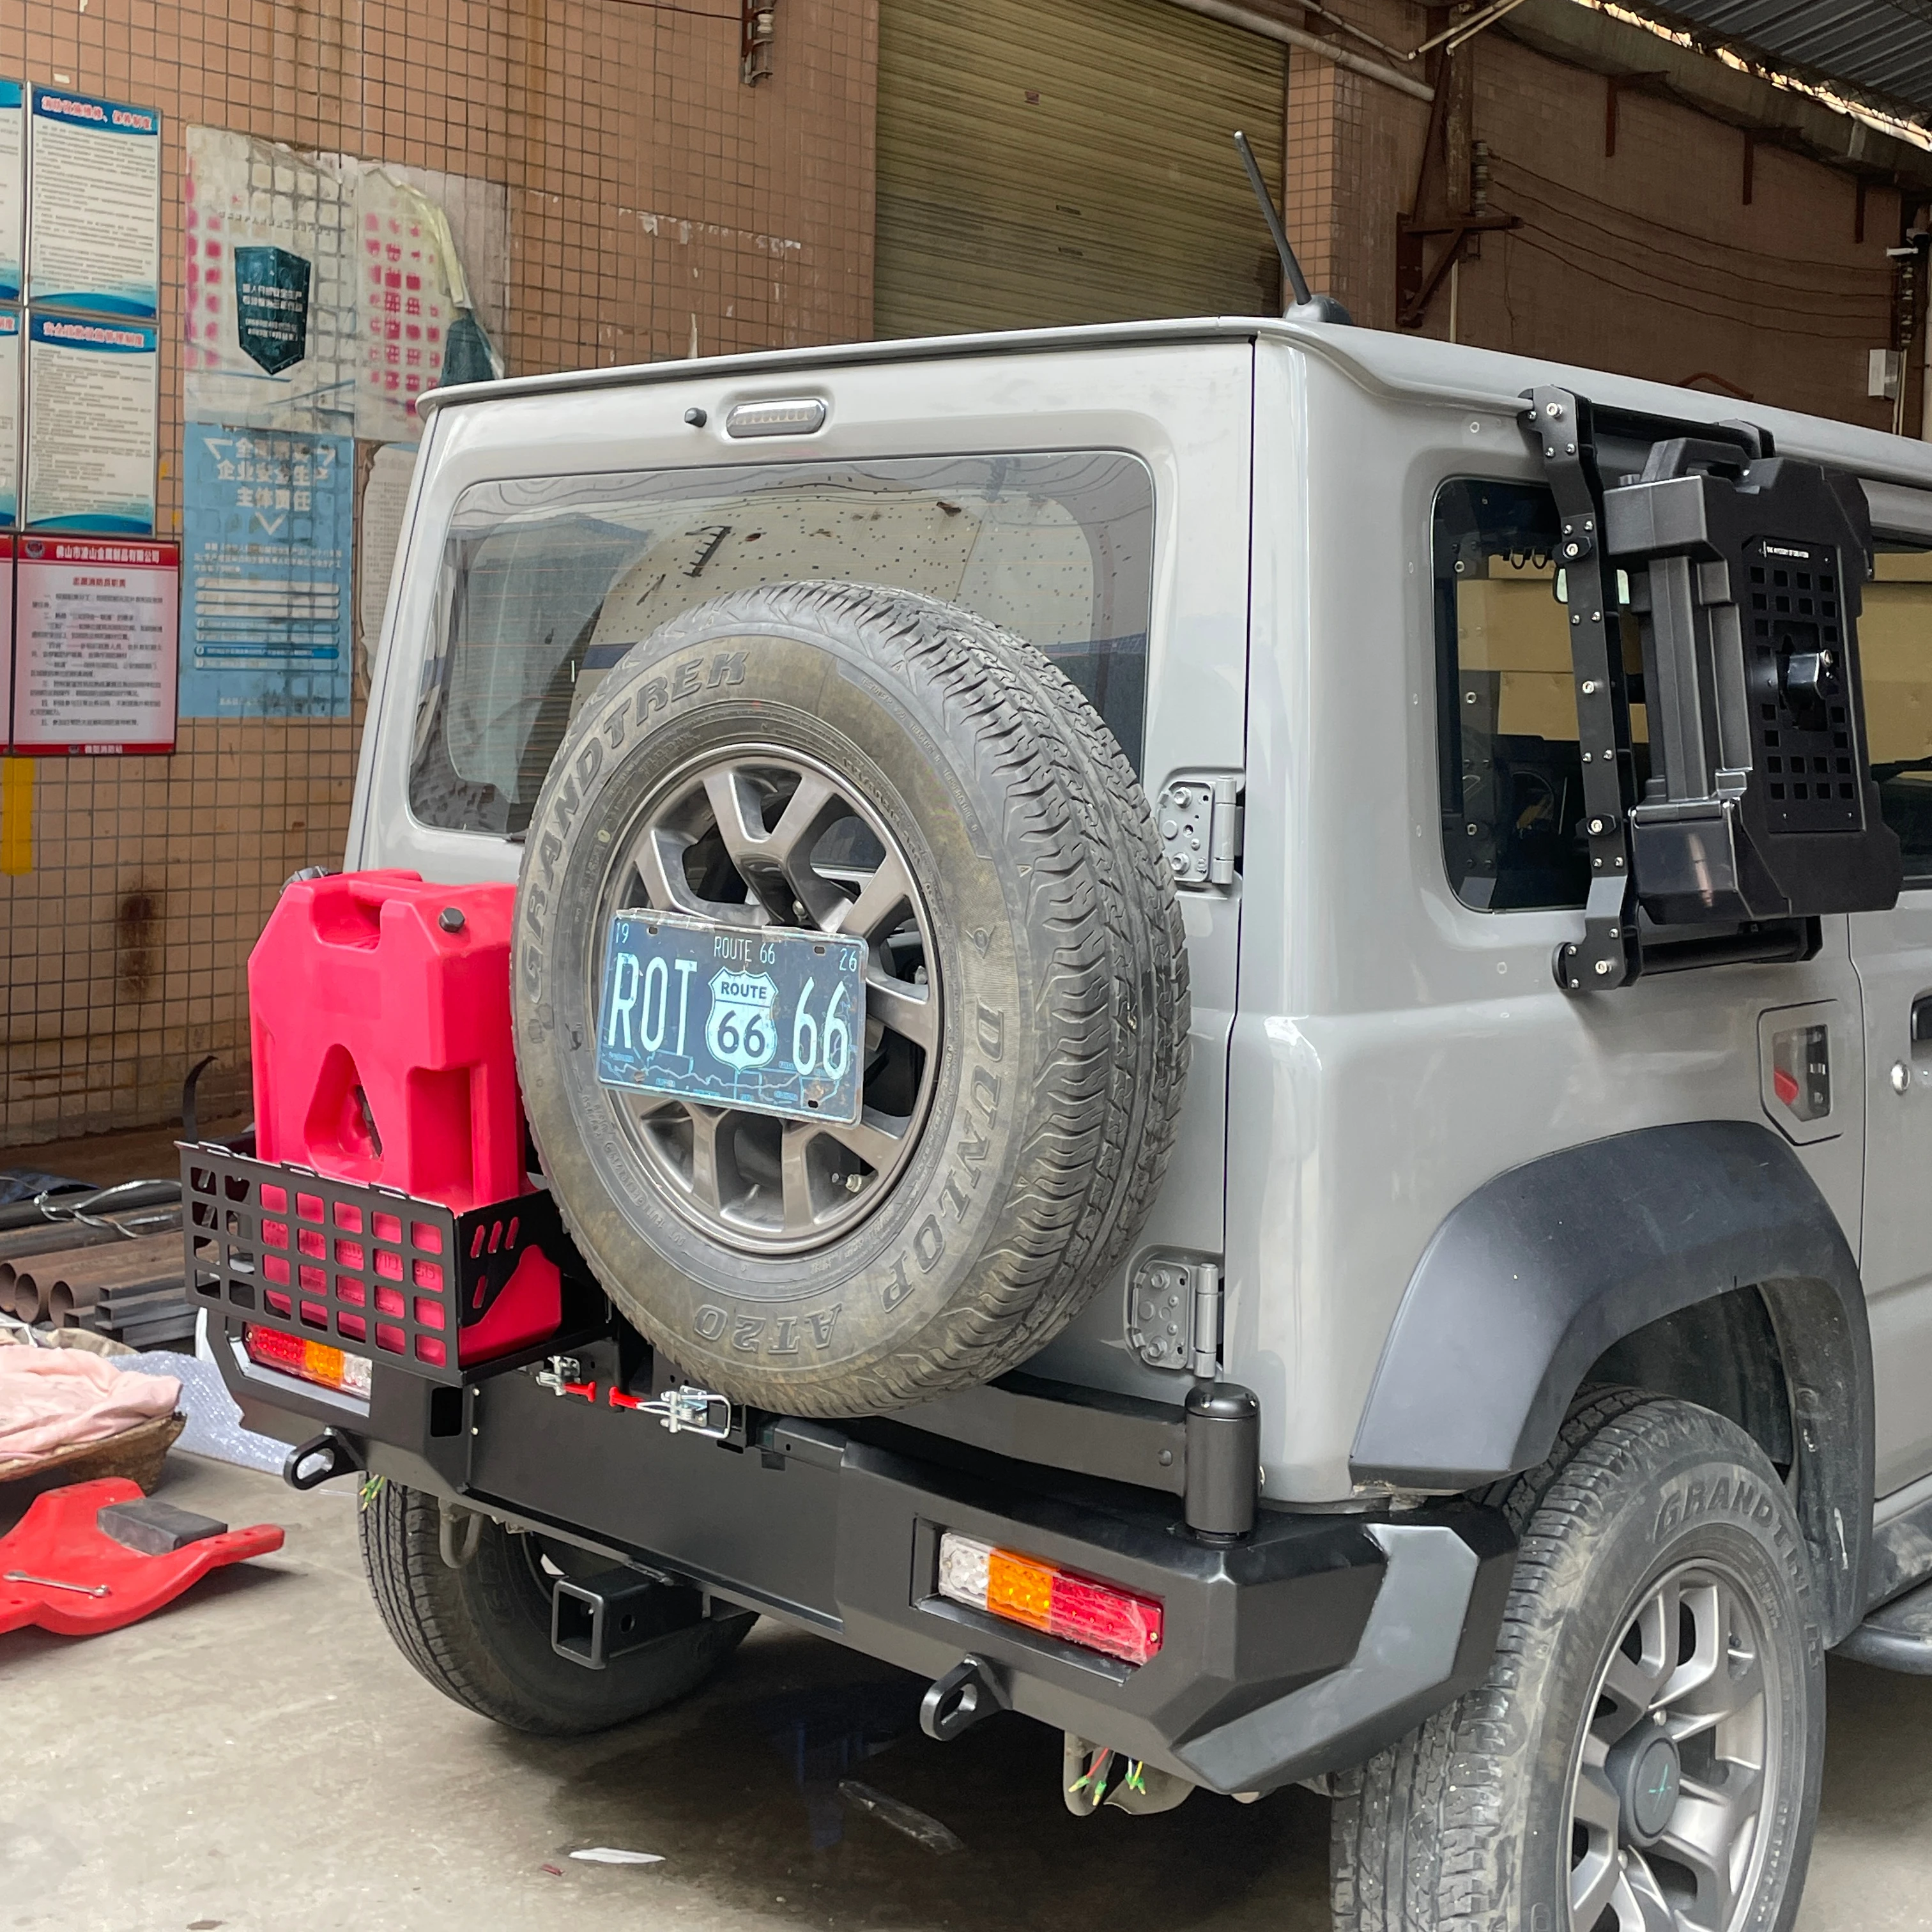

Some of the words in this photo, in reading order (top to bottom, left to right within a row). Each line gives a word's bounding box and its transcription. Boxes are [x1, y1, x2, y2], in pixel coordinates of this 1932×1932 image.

[523, 651, 751, 1004] GRANDTREK
[615, 922, 629, 944] 19
[714, 936, 753, 963] ROUTE
[760, 942, 776, 965] 66
[839, 947, 857, 972] 26
[720, 980, 767, 1000] ROUTE
[608, 952, 698, 1057] ROT
[793, 976, 849, 1081] 66
[717, 1010, 765, 1058] 66
[880, 995, 1005, 1314] DUNLOP
[693, 1301, 843, 1354] AT20
